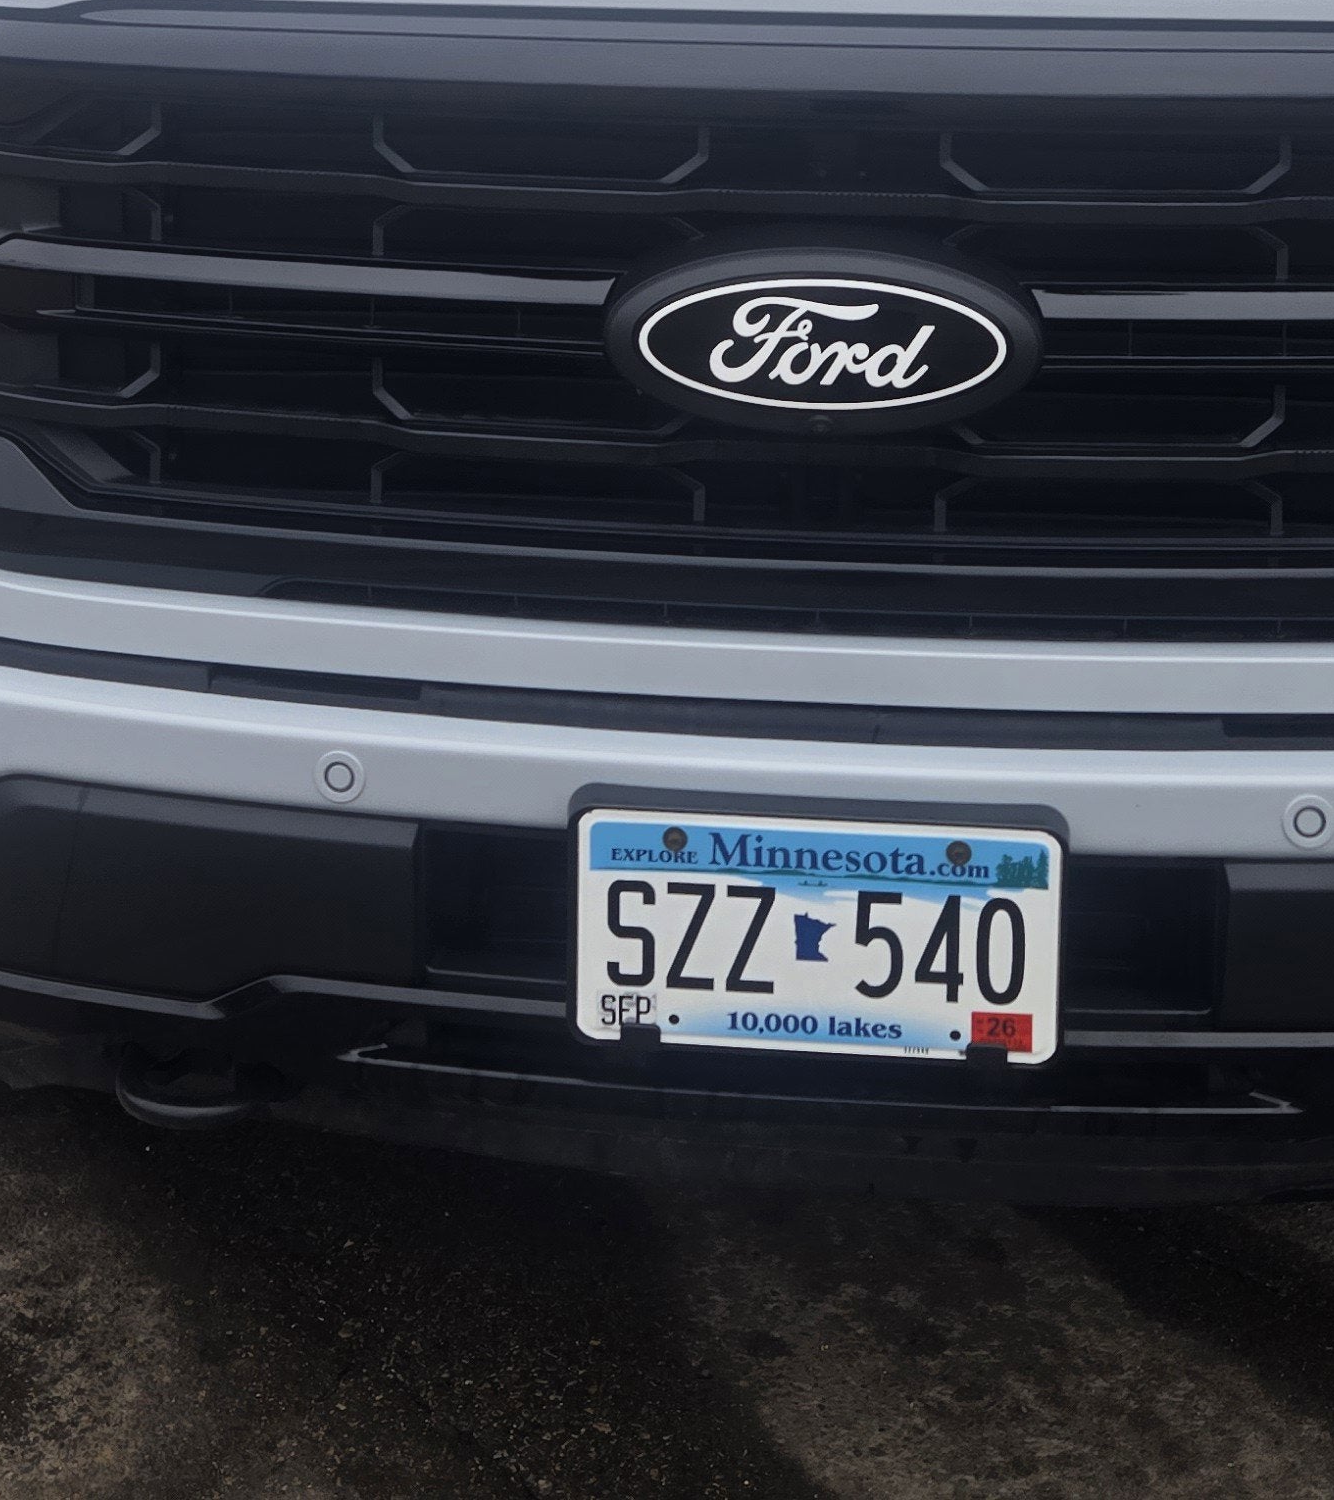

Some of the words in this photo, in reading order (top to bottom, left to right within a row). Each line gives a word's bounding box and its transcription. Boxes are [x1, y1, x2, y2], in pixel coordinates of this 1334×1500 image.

[709, 296, 935, 389] Ford
[610, 846, 699, 865] EXPLORE
[708, 831, 990, 880] Minnesota.com
[606, 879, 777, 994] SZZ
[854, 889, 1026, 1006] 540
[726, 1010, 819, 1037] 10,000
[827, 1015, 903, 1040] lakes
[986, 1016, 1017, 1038] 26
